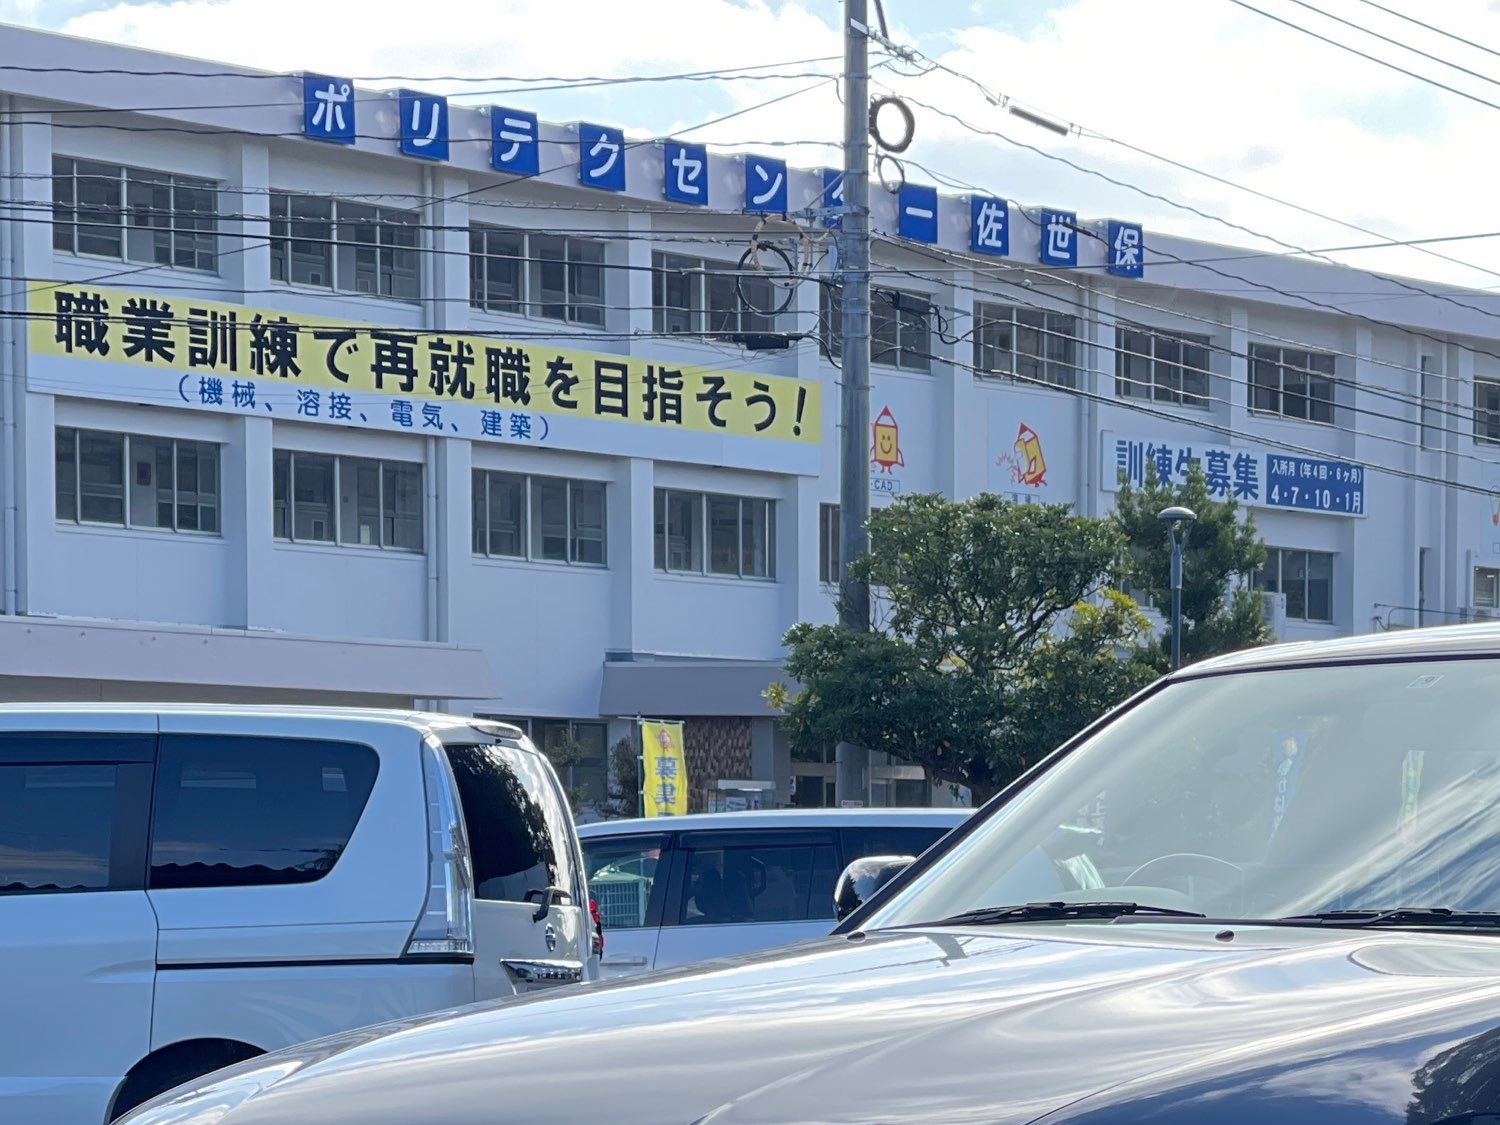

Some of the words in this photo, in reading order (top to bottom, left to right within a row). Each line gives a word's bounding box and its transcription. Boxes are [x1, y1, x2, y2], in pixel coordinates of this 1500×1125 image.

[311, 83, 1139, 270] ポリテクセンー佐世保
